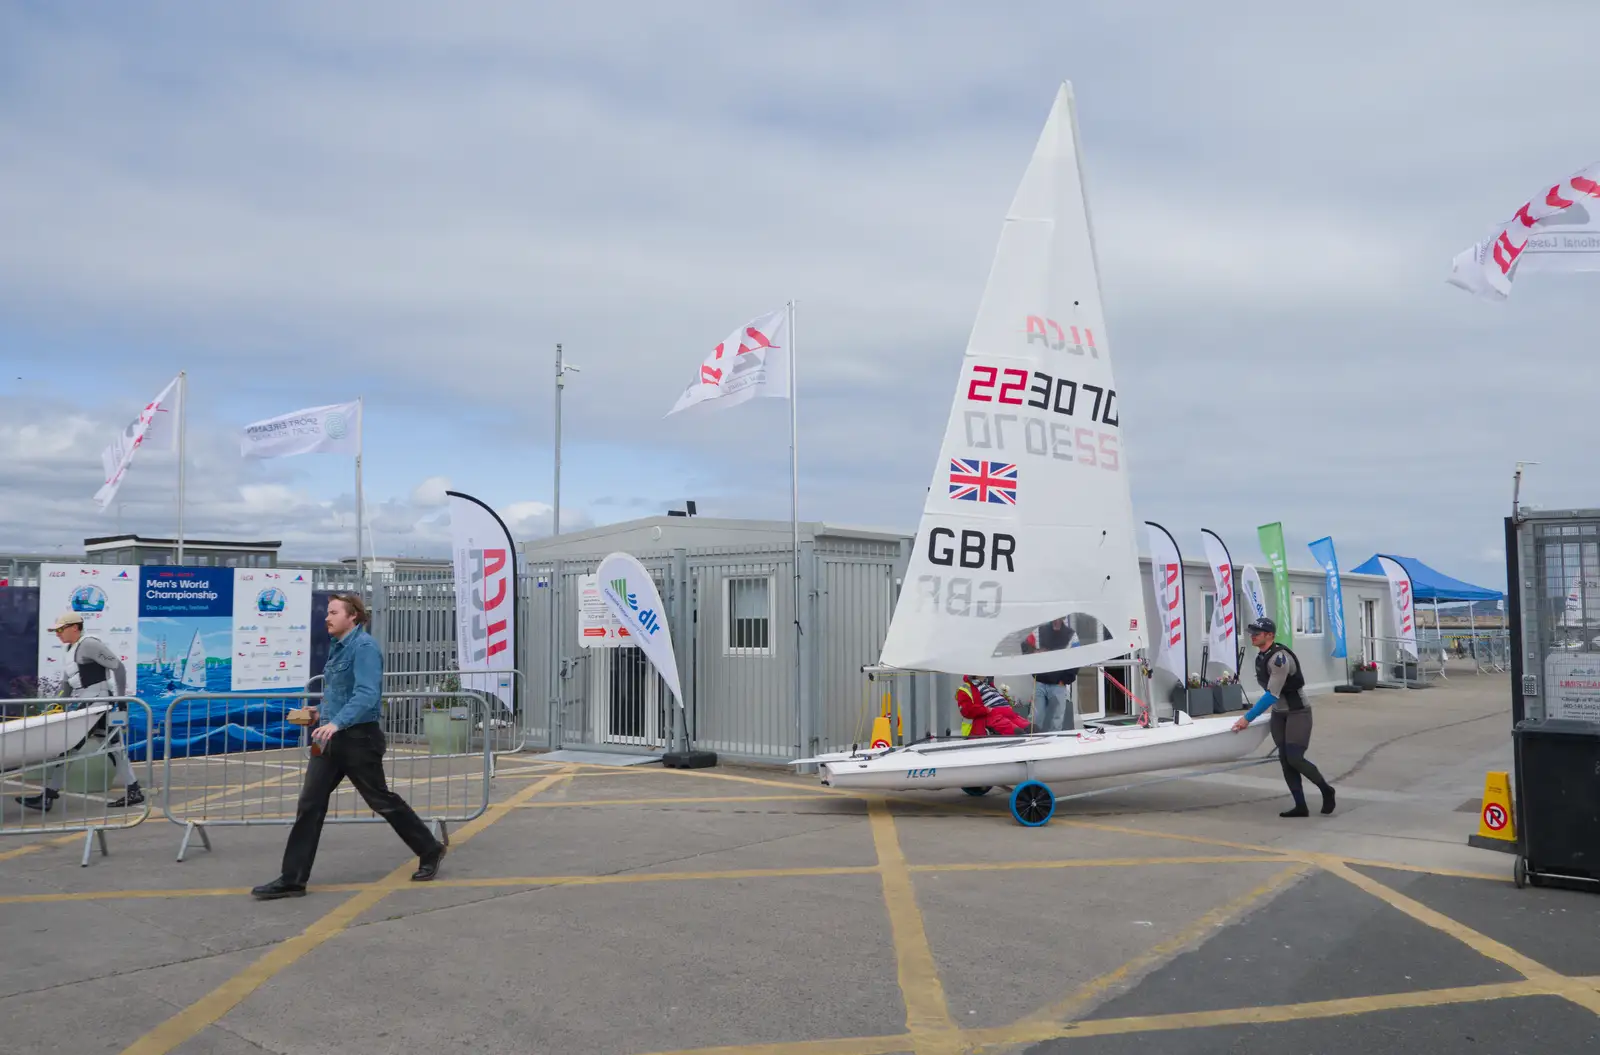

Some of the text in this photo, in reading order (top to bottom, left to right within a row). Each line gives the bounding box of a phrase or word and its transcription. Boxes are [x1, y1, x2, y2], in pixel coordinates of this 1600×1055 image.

[967, 365, 1119, 428] 223070
[928, 527, 1016, 573] GBR
[146, 579, 209, 589] Men's World
[146, 589, 218, 600] Championship
[638, 608, 660, 636] dlr
[906, 767, 937, 779] ILCA
